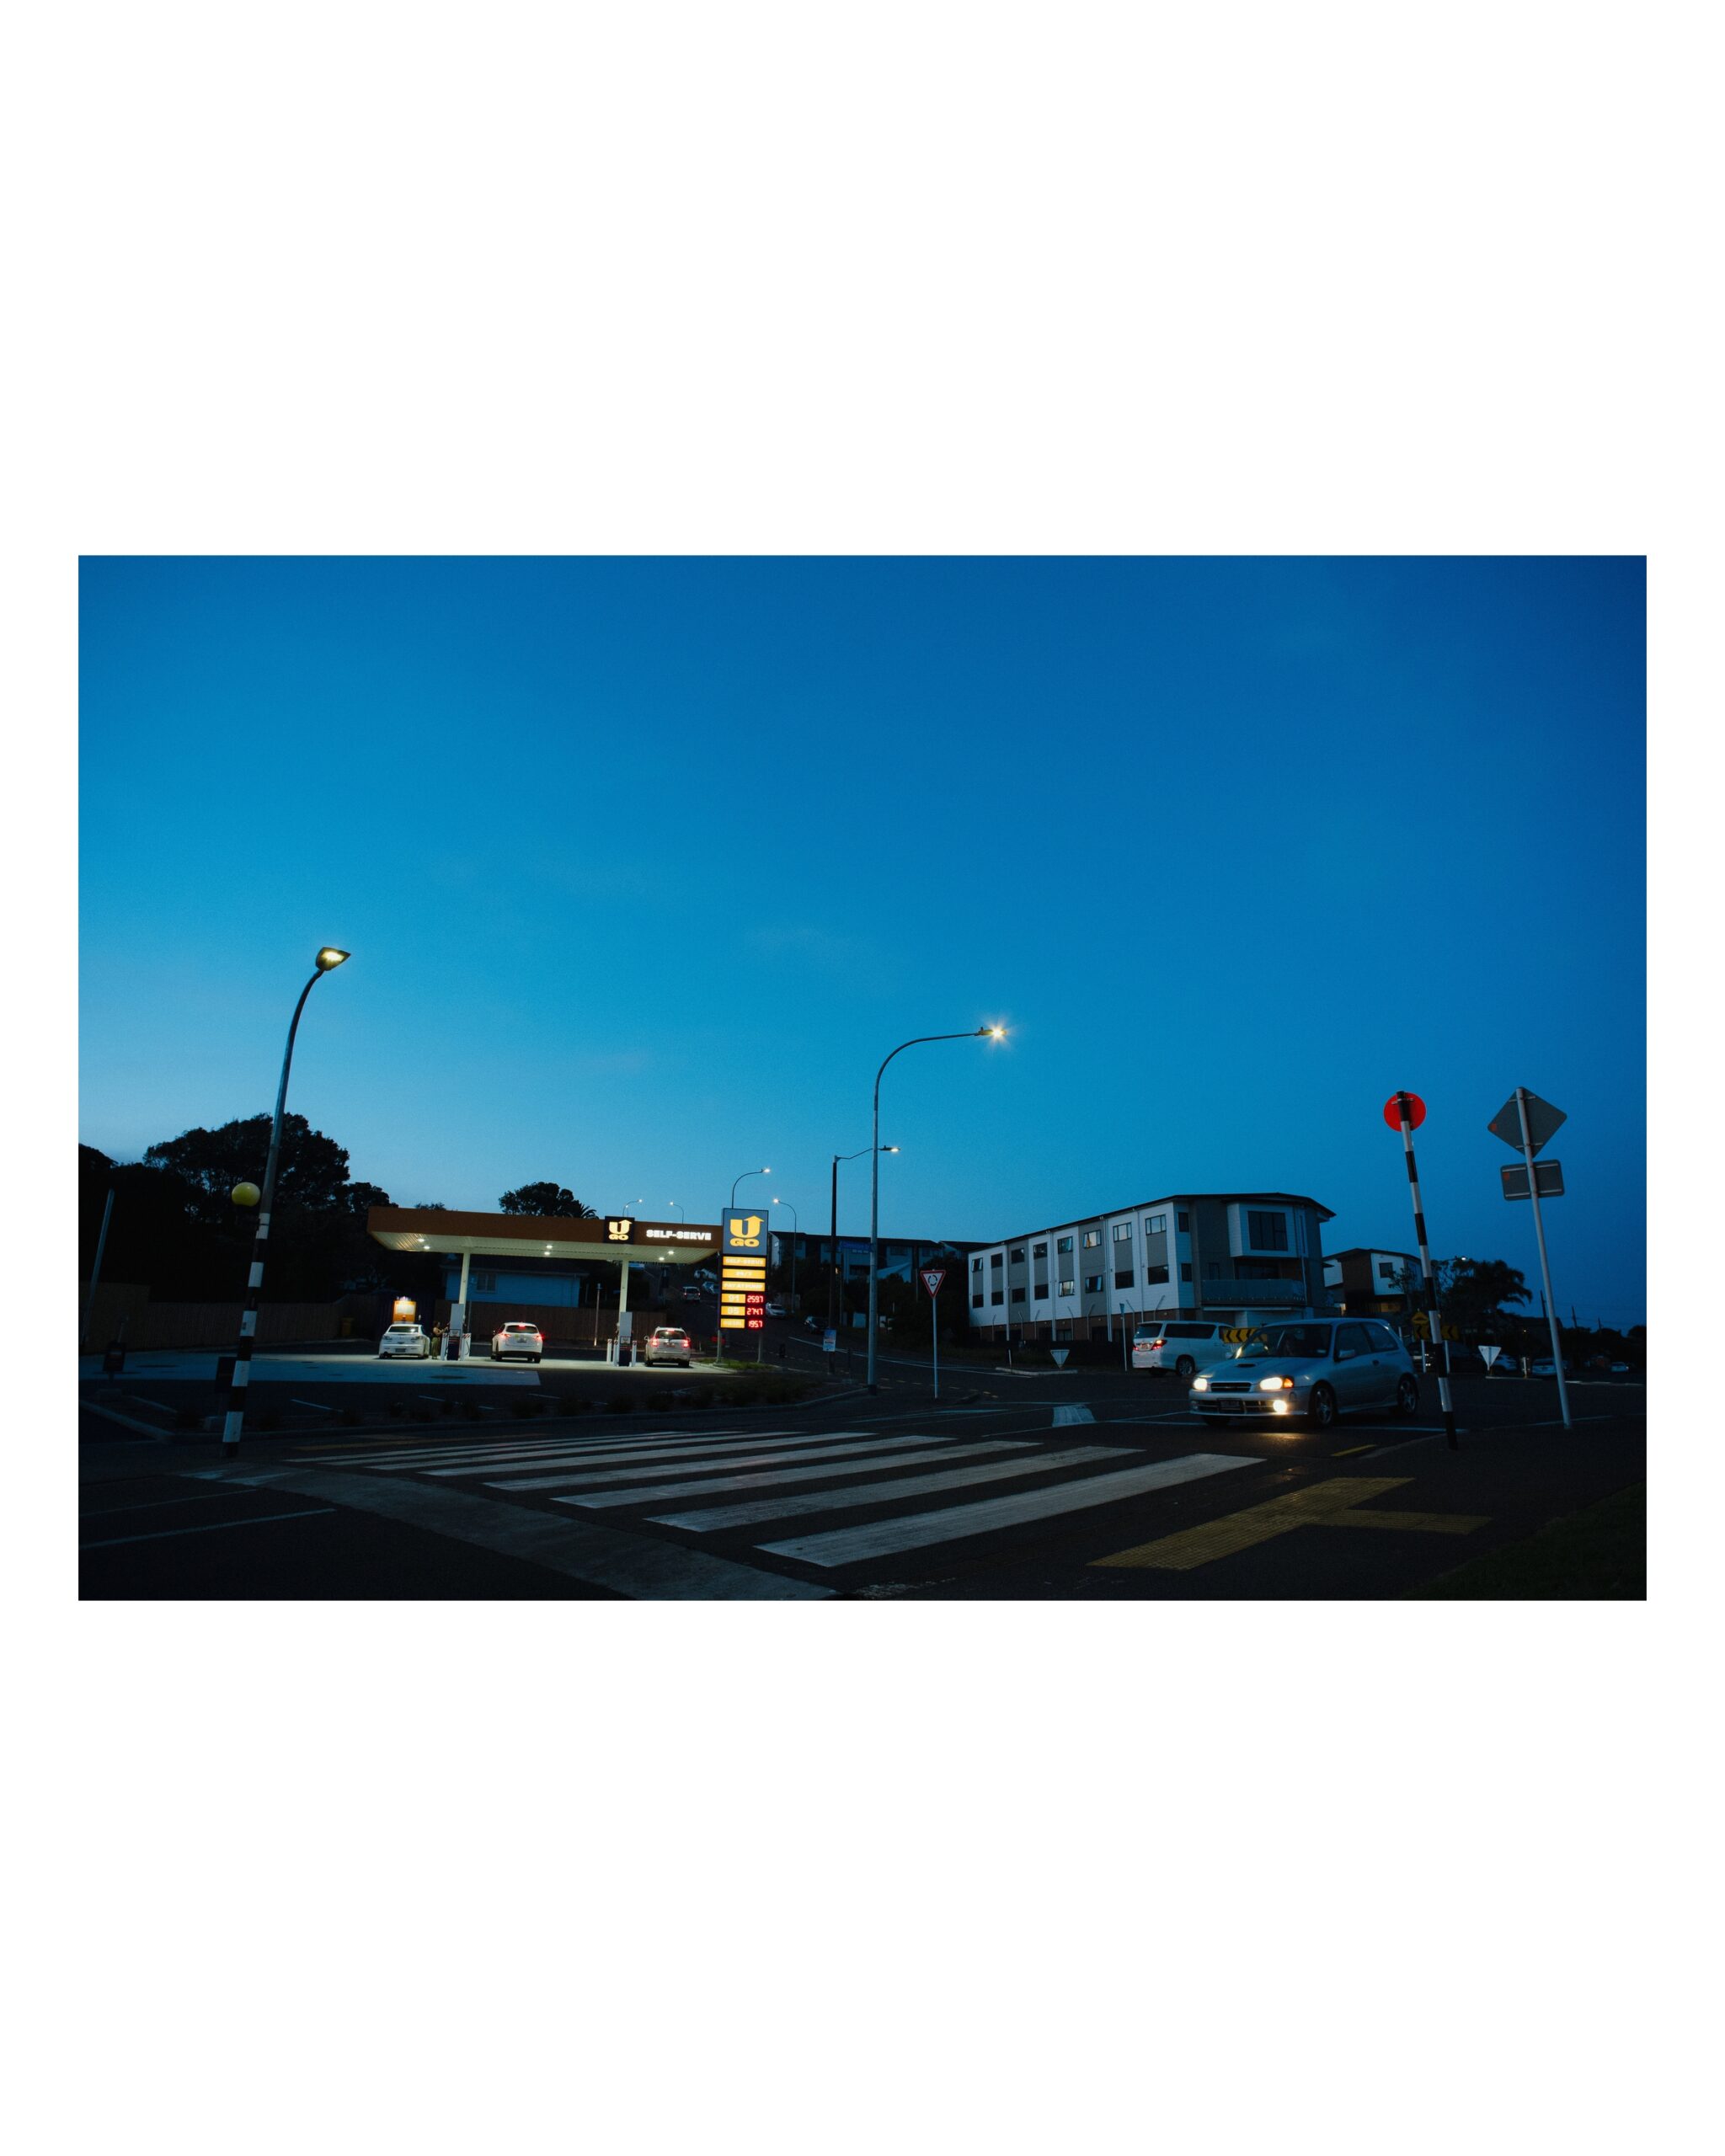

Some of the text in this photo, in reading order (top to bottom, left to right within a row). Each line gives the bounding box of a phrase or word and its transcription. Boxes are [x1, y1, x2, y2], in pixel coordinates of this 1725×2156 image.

[730, 1215, 765, 1238] U
[646, 1230, 712, 1241] SELF-SERVE
[729, 1238, 760, 1247] GO
